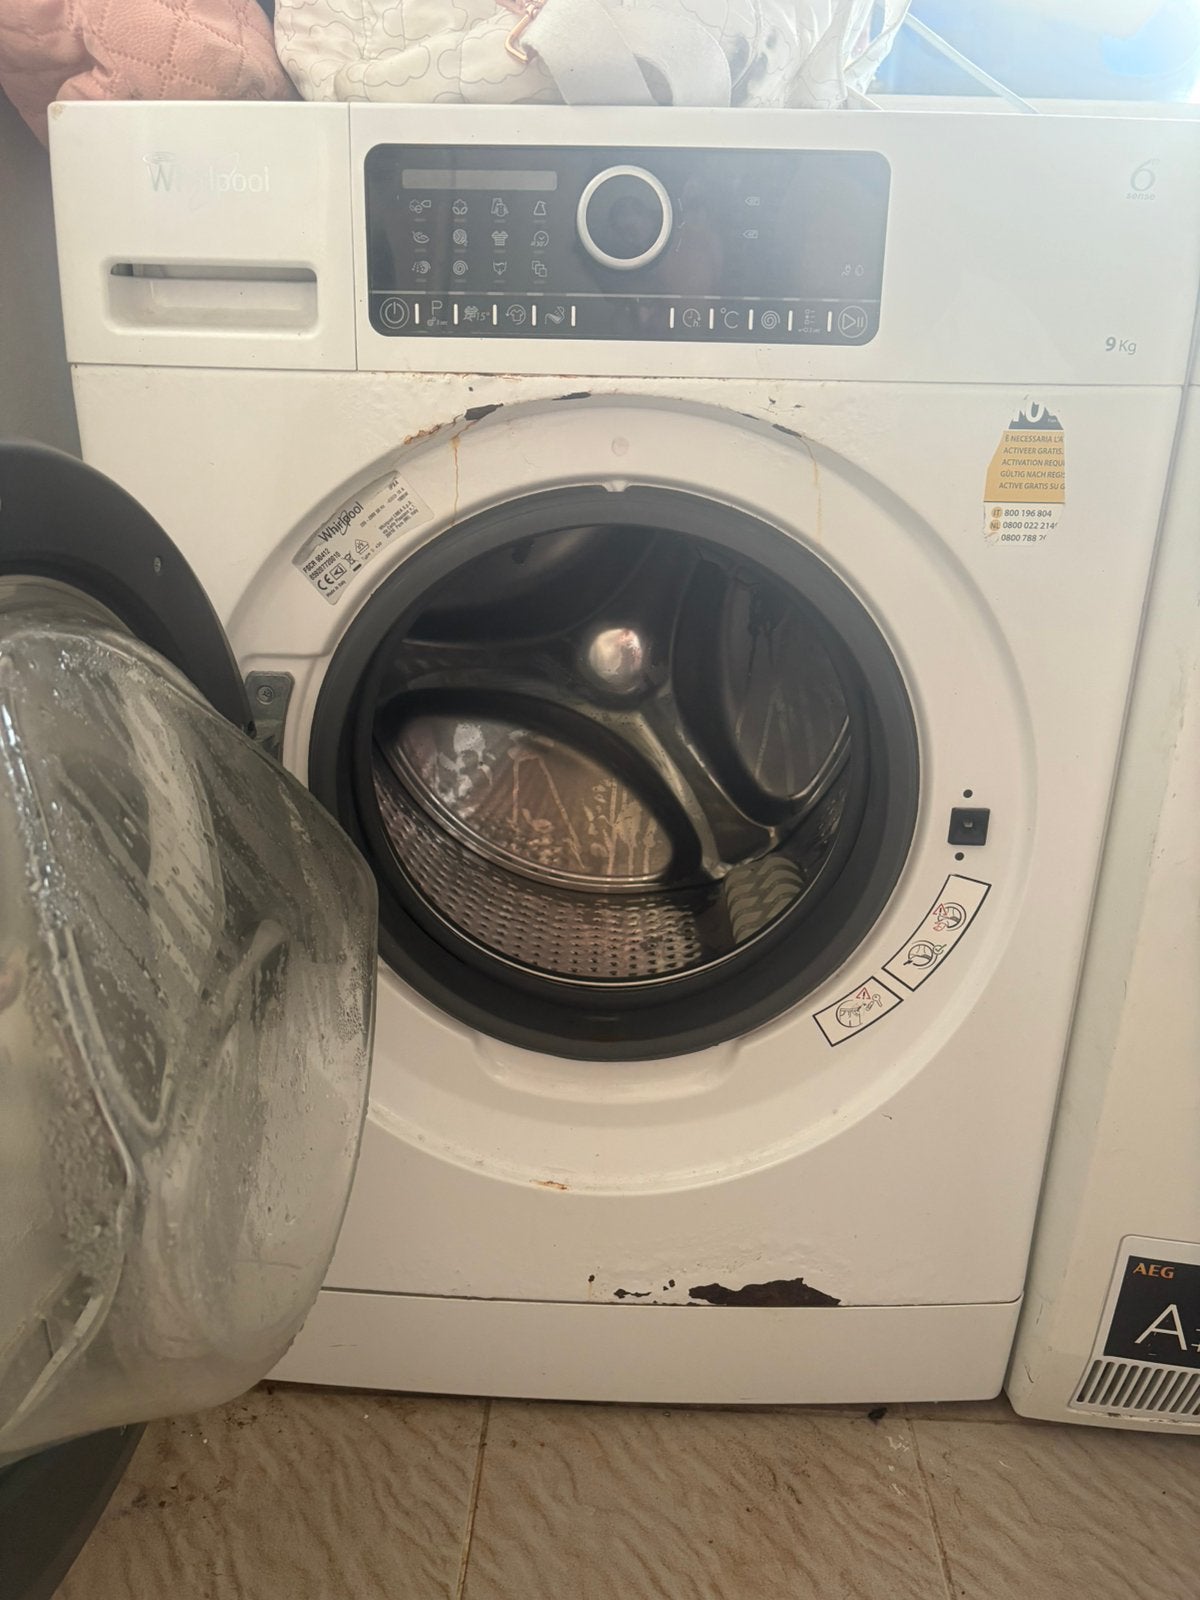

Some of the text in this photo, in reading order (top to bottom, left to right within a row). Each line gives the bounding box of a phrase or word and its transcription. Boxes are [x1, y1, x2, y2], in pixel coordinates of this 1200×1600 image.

[1105, 337, 1137, 355] 9 Kg
[1011, 435, 1053, 443] NECESSARIA
[1003, 447, 1037, 455] ACTIVEER
[1001, 459, 1043, 467] ACTIVATION
[1000, 469, 1026, 478] GÜLTIG
[1024, 482, 1049, 490] GRATIS
[1004, 509, 1052, 517] 800 196 804
[318, 501, 364, 542] Whirlpool
[1002, 521, 1022, 529] 0800
[1024, 521, 1039, 529] 022
[1001, 534, 1020, 542] 0800
[1022, 534, 1037, 542] 788
[1132, 1262, 1175, 1280] AEG
